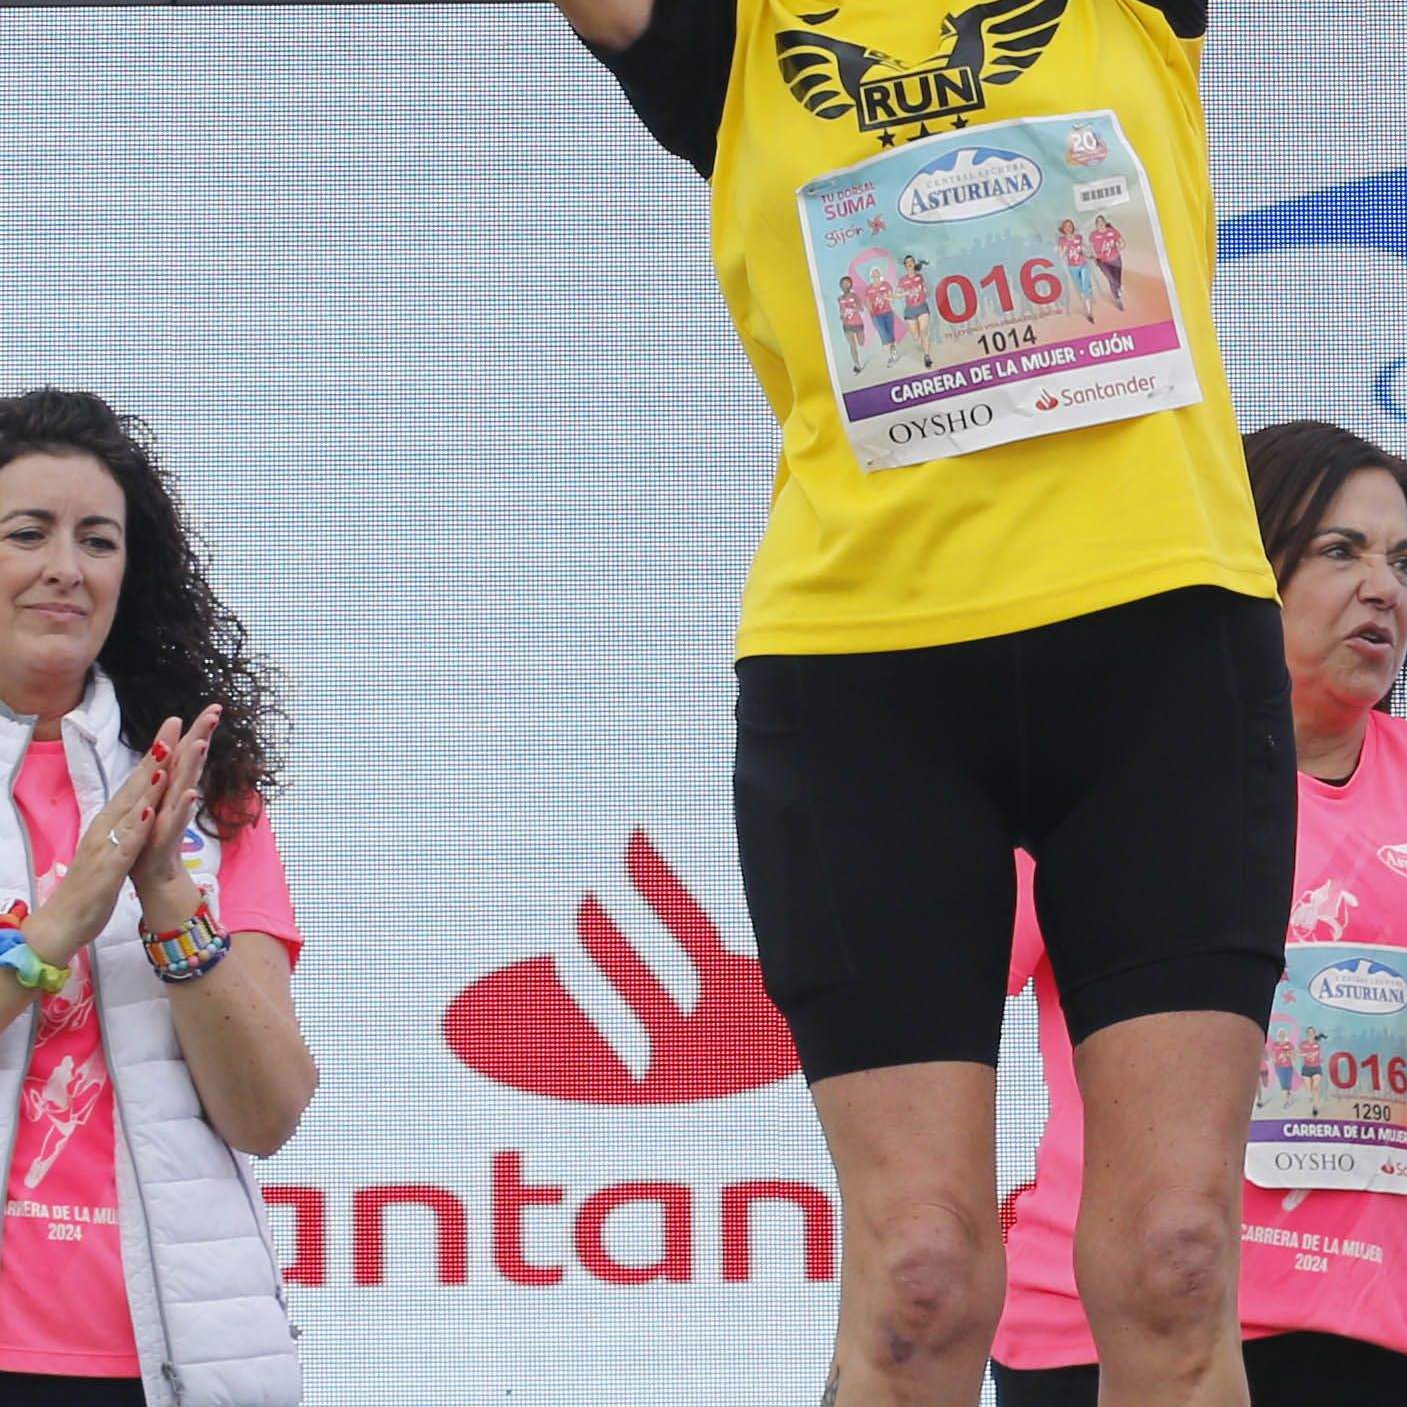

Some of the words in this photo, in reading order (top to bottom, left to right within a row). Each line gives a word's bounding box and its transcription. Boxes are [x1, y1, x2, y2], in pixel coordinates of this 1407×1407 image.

[864, 68, 977, 123] RUN
[1071, 128, 1098, 153] 20
[838, 181, 876, 201] DORSAL
[910, 171, 1035, 216] ASTURIANA
[823, 193, 877, 222] SUMA
[935, 257, 1063, 326] 016
[977, 325, 1038, 355] 1014
[890, 373, 967, 405] CARRERA
[970, 364, 993, 385] DE
[996, 357, 1019, 378] LA
[1021, 347, 1077, 373] MUJER
[1088, 332, 1136, 356] GIJÓN
[1060, 374, 1157, 409] Santander
[888, 402, 994, 447] OYSHO
[1353, 1103, 1392, 1122] 1290
[1283, 1123, 1342, 1139] CARRERA
[1344, 1125, 1358, 1139] DE
[1360, 1127, 1376, 1141] LA
[1275, 1151, 1355, 1173] OYSHO
[52, 1205, 71, 1221] DE
[73, 1206, 91, 1223] LA
[47, 1222, 83, 1242] 2024
[1295, 1253, 1329, 1273] 2024
[1302, 1233, 1321, 1252] DE
[1323, 1236, 1340, 1255] LA
[1342, 1239, 1384, 1264] MUJER
